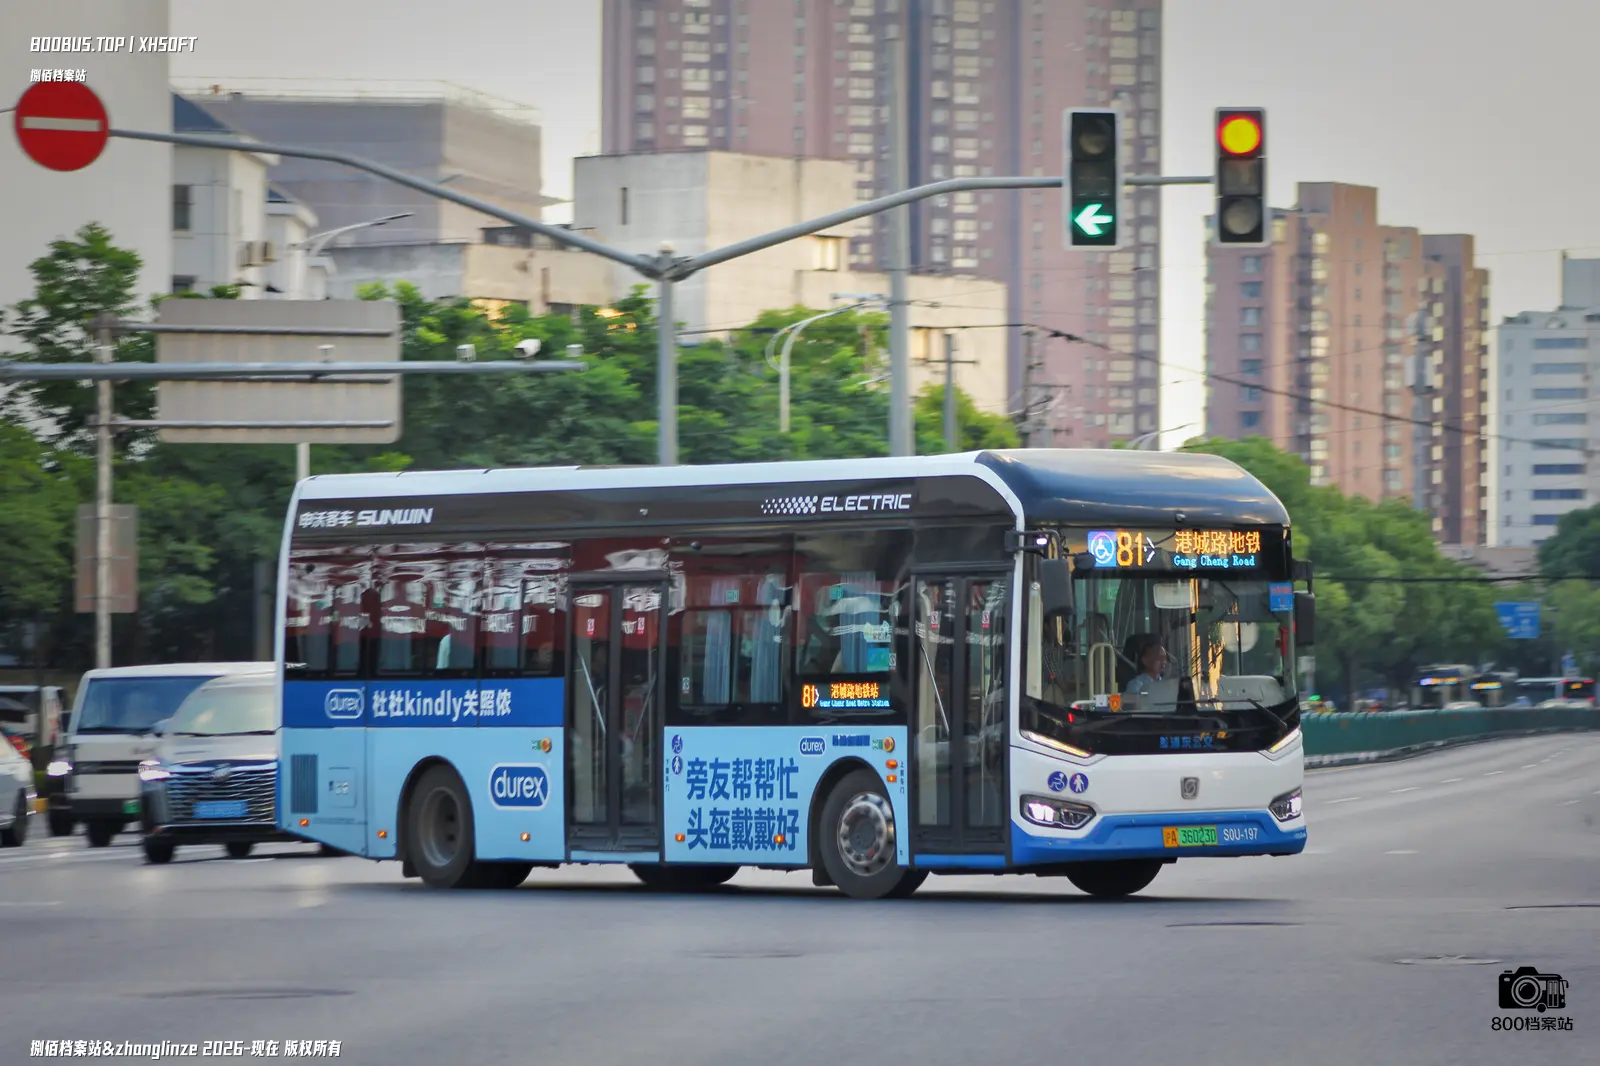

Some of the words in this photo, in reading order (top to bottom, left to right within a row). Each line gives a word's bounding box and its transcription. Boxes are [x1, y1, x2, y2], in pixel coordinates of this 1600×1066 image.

[820, 494, 912, 512] ELECTRIC
[299, 510, 355, 528] 申沃客车
[356, 508, 434, 526] SUNWIN
[1117, 532, 1143, 567] 81
[1175, 531, 1261, 555] 港城路地铁
[1173, 555, 1198, 568] Gang
[1200, 555, 1229, 569] Cheng
[1232, 555, 1255, 566] Road
[328, 692, 361, 713] durex
[803, 684, 815, 708] 81
[801, 739, 824, 752] durex
[494, 769, 545, 799] durex
[686, 757, 799, 801] 旁友帮帮忙
[686, 807, 799, 851] 头盔戴戴好
